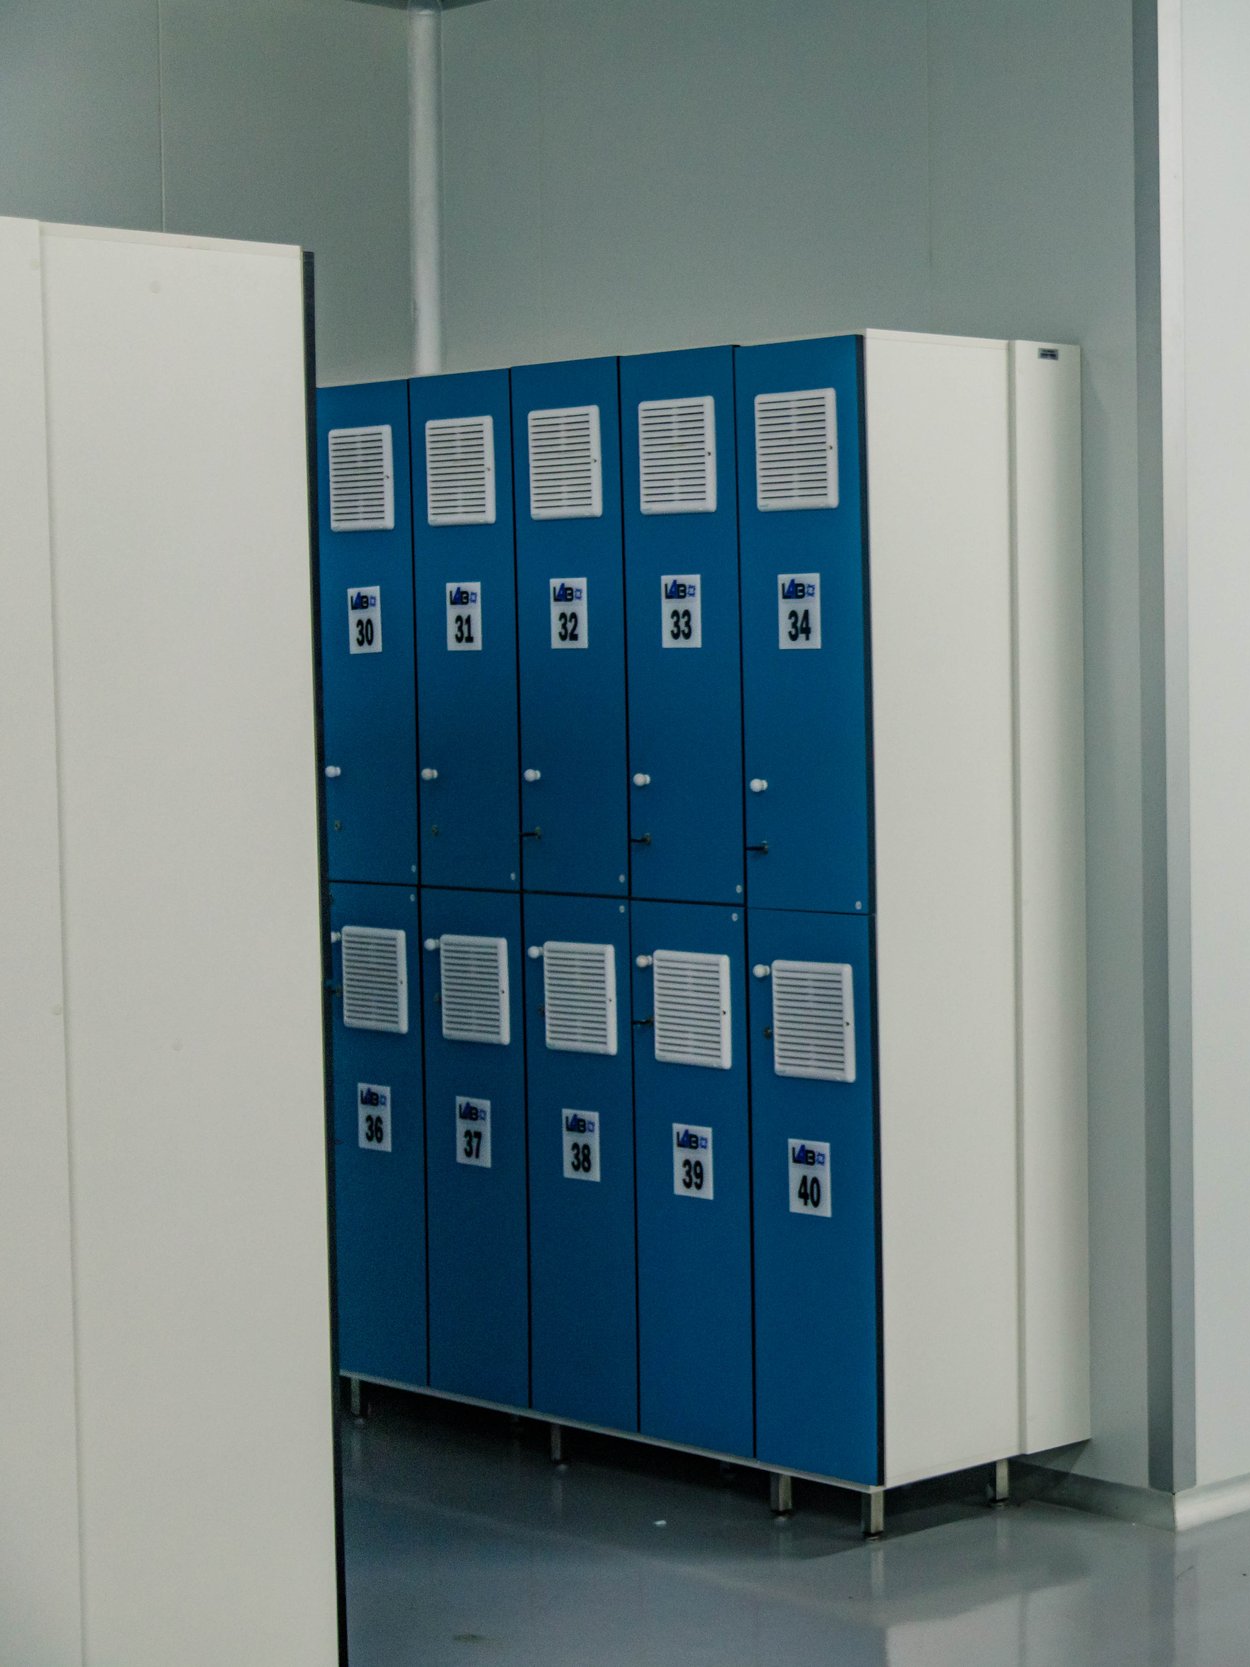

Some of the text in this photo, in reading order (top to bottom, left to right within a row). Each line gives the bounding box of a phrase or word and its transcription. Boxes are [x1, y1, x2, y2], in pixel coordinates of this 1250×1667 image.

[356, 618, 374, 647] 30
[454, 615, 474, 643] 31
[558, 612, 579, 641] 32
[670, 609, 692, 640] 33
[788, 609, 811, 641] 34
[365, 1114, 384, 1144] 36
[463, 1129, 483, 1159] 37
[571, 1142, 592, 1173] 38
[682, 1159, 704, 1191] 39
[798, 1174, 821, 1208] 40
